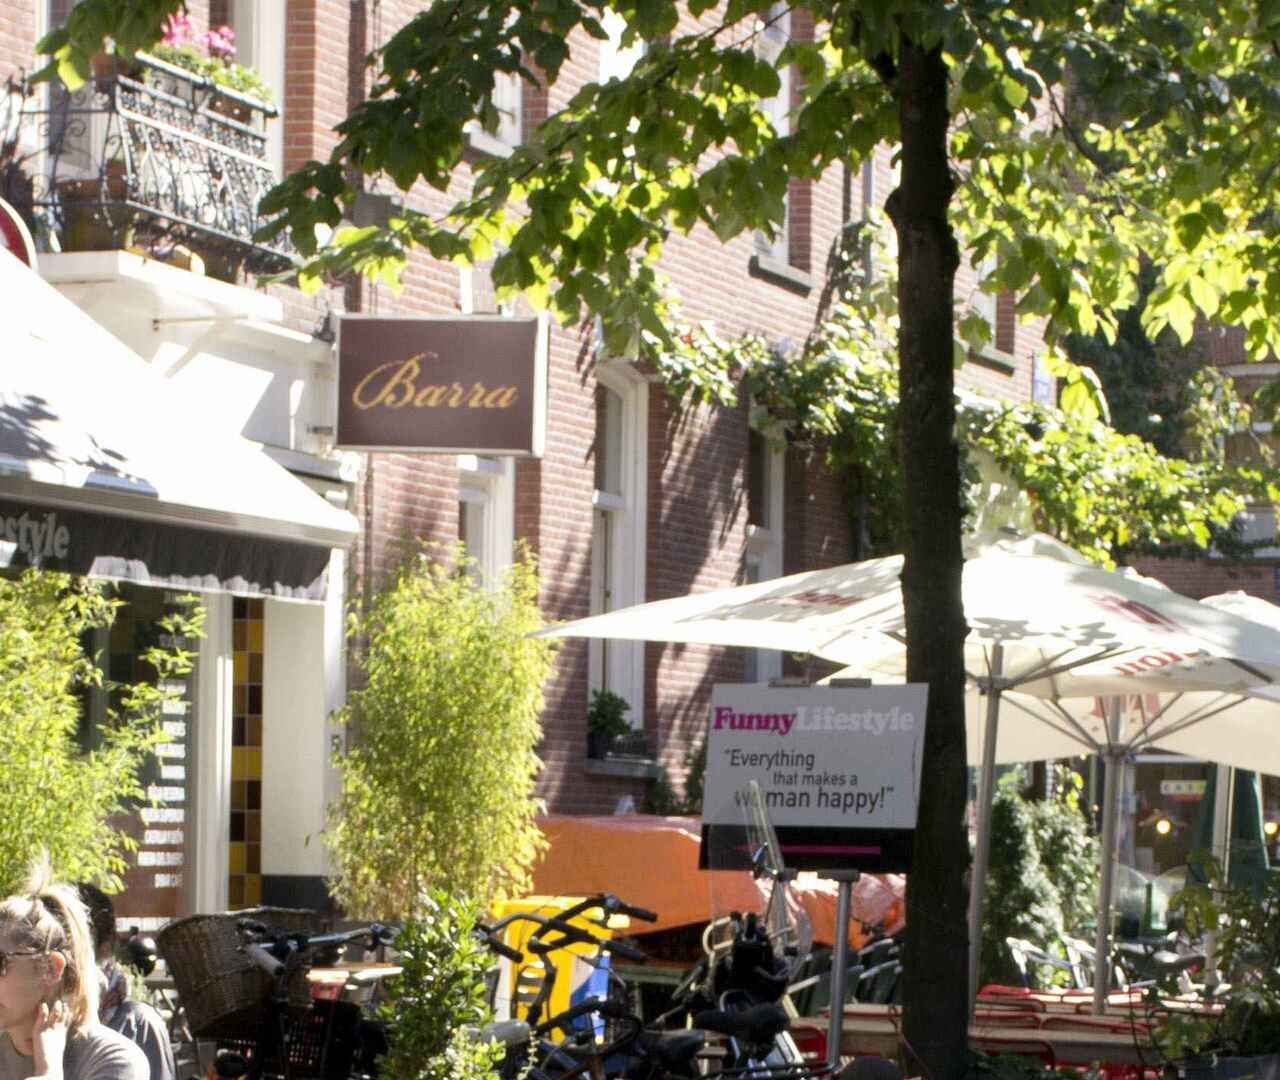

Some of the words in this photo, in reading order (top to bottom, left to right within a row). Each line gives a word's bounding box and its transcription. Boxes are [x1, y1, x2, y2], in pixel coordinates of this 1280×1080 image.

[352, 352, 519, 411] Barra
[773, 772, 798, 786] that
[802, 771, 847, 786] makes
[850, 774, 859, 786] a
[734, 789, 811, 809] wman
